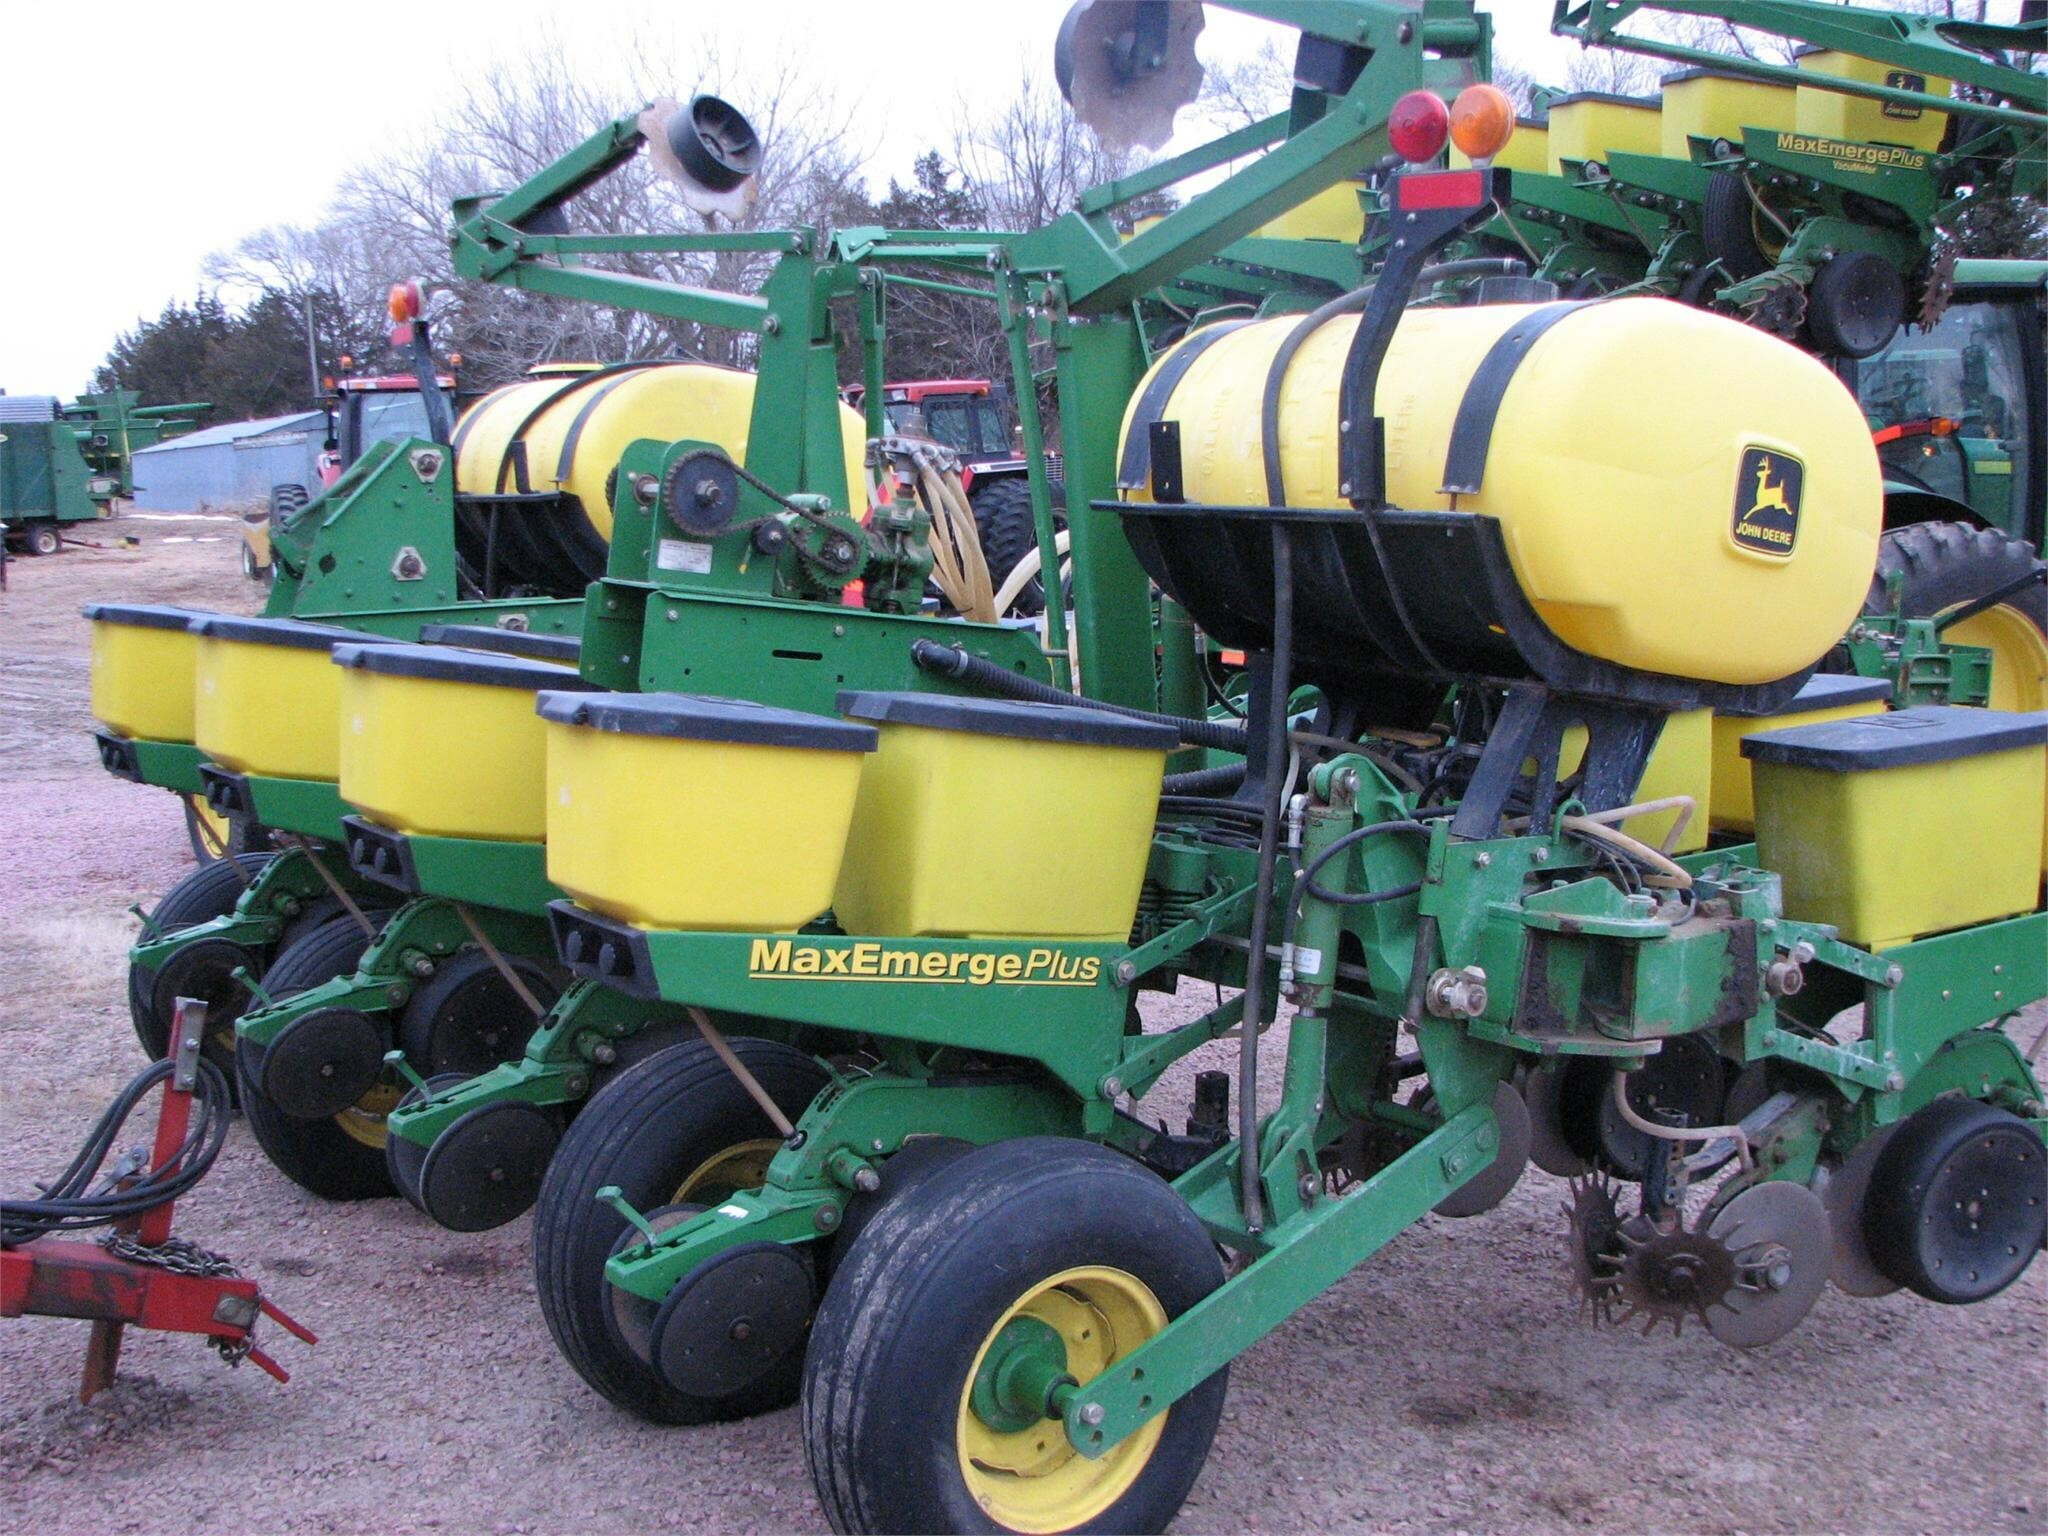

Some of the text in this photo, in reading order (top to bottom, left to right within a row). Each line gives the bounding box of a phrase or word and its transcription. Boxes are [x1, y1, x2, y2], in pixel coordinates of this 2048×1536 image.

[1777, 133, 1925, 167] MaxEmergePlus
[1736, 522, 1792, 545] JOHN DEERE
[750, 939, 1100, 985] MaxEmergePlus
